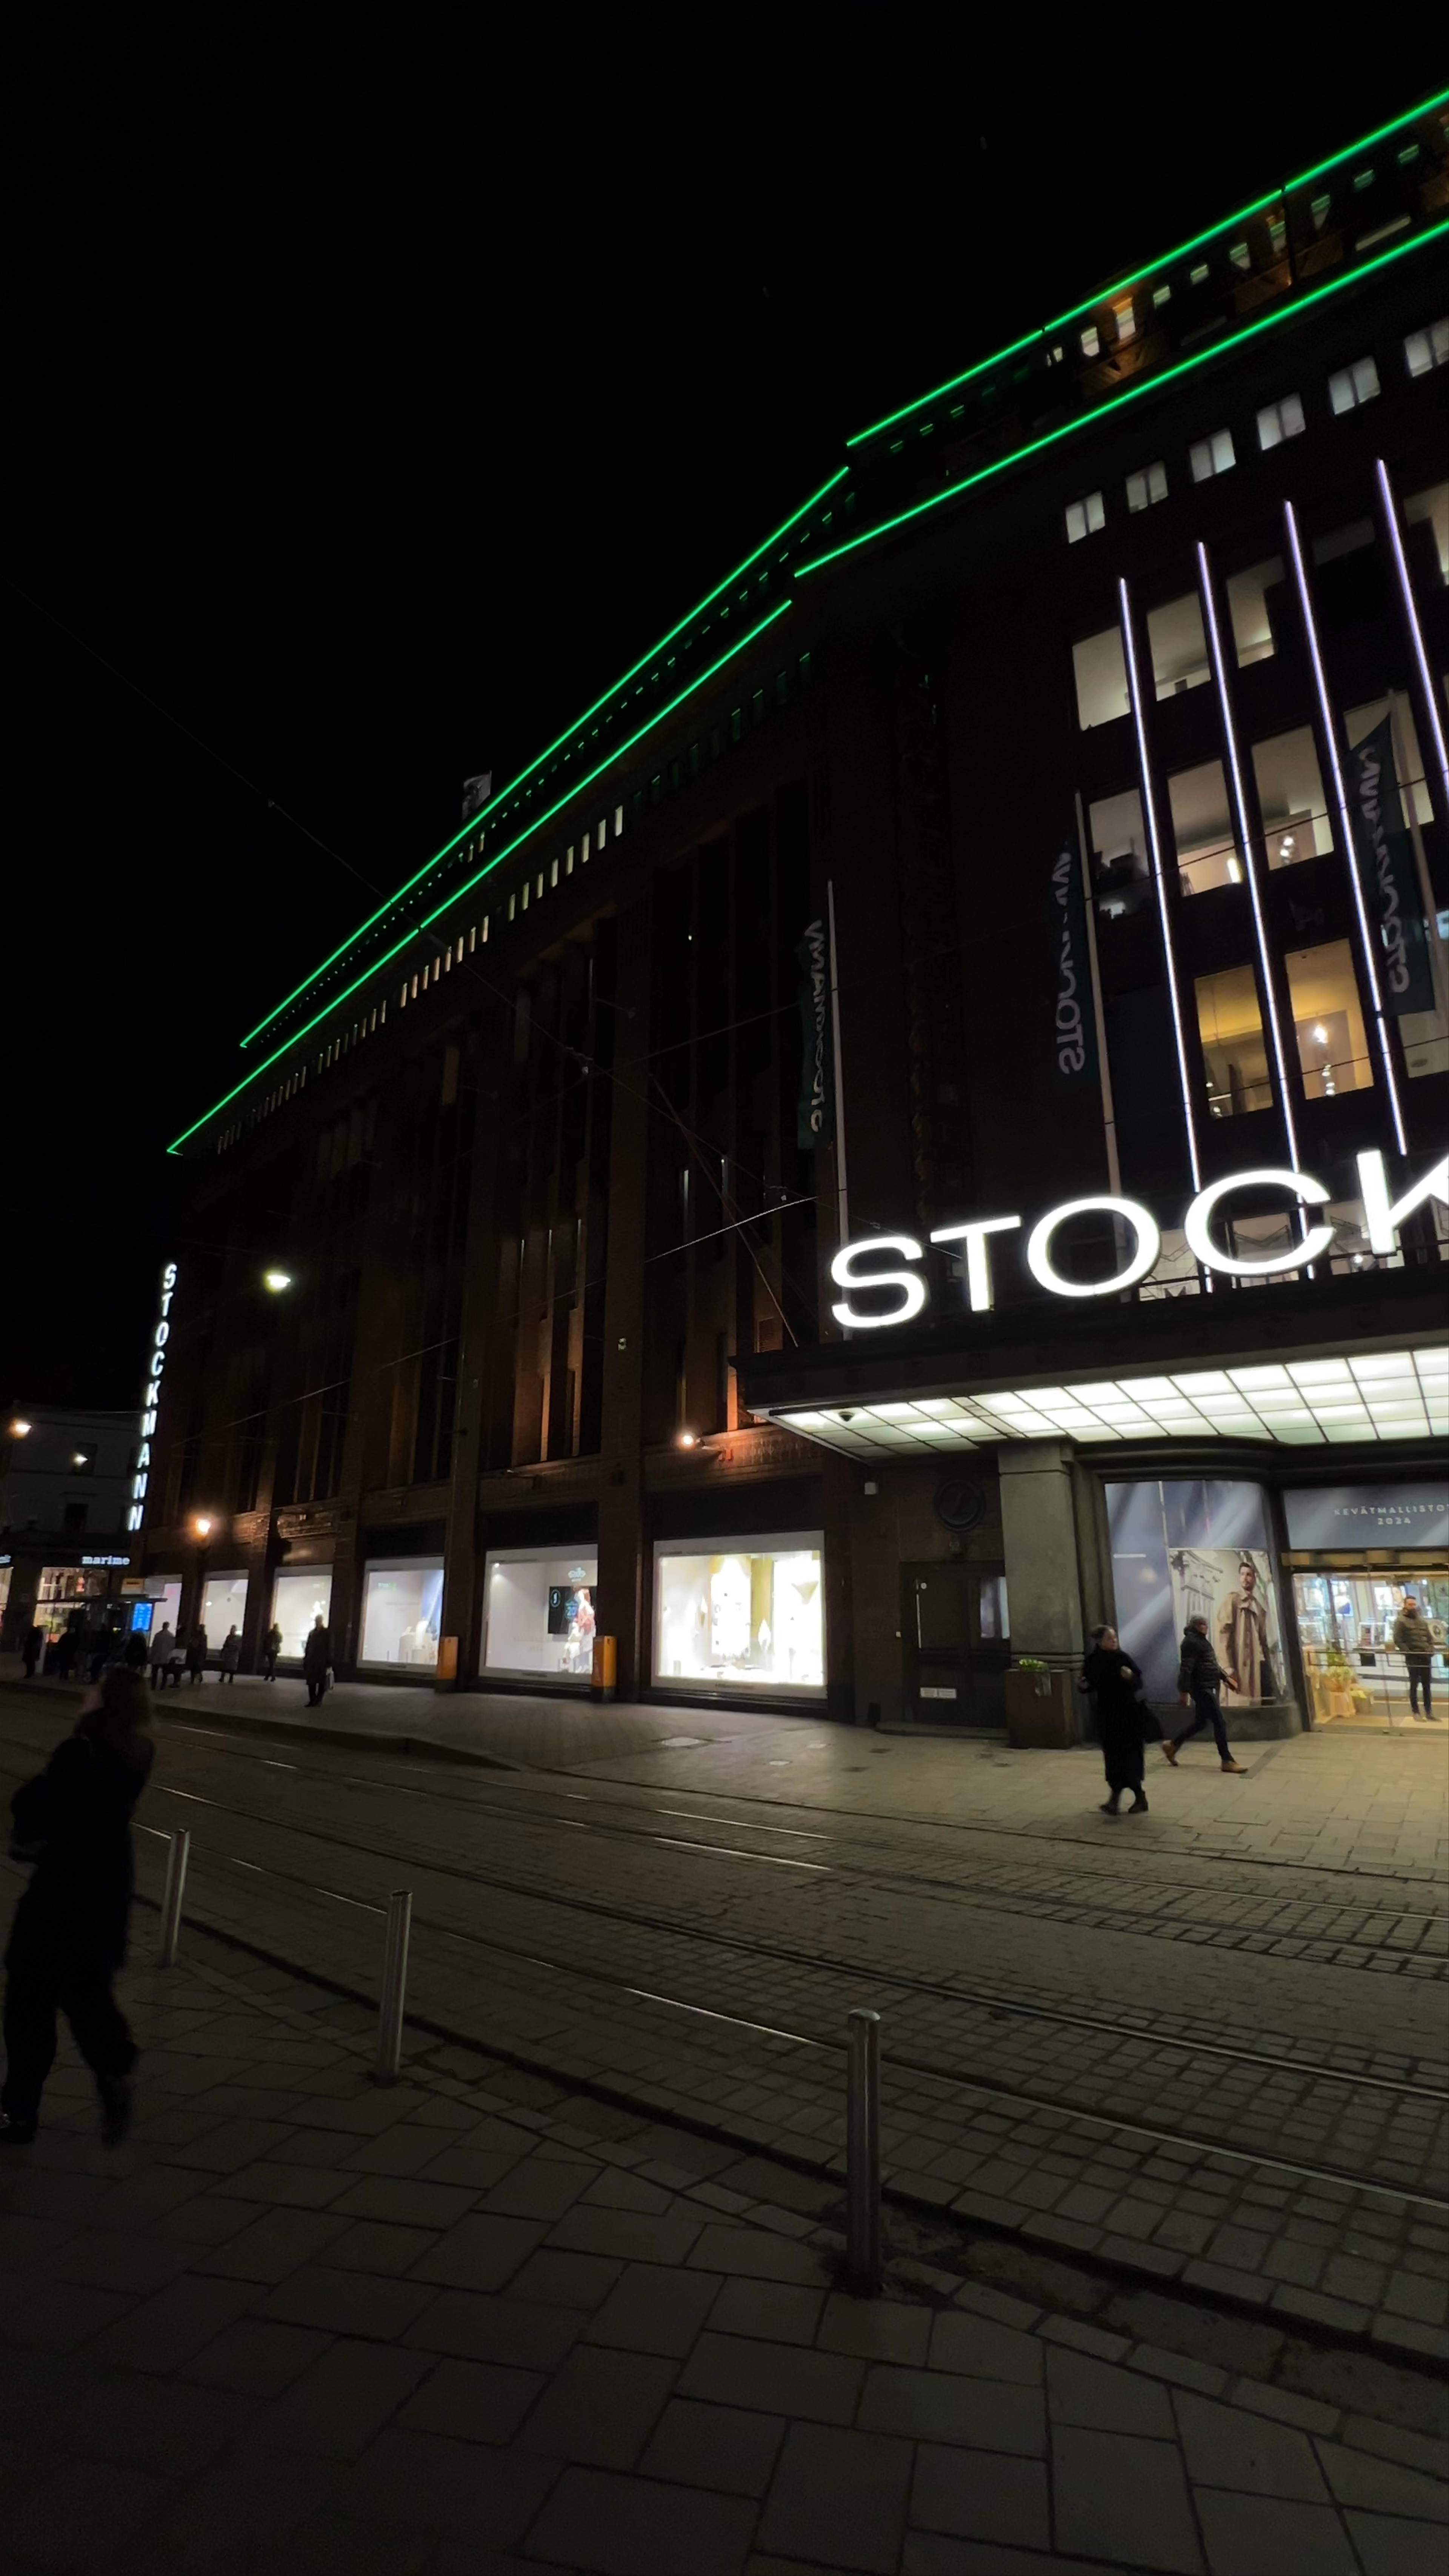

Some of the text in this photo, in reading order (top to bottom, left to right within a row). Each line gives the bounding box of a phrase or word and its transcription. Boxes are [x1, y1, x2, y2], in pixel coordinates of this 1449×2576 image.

[830, 1149, 1449, 1329] STOCK
[128, 1263, 177, 1532] STOCKMANN
[1335, 1503, 1449, 1515] KEVÄTMALLISTO
